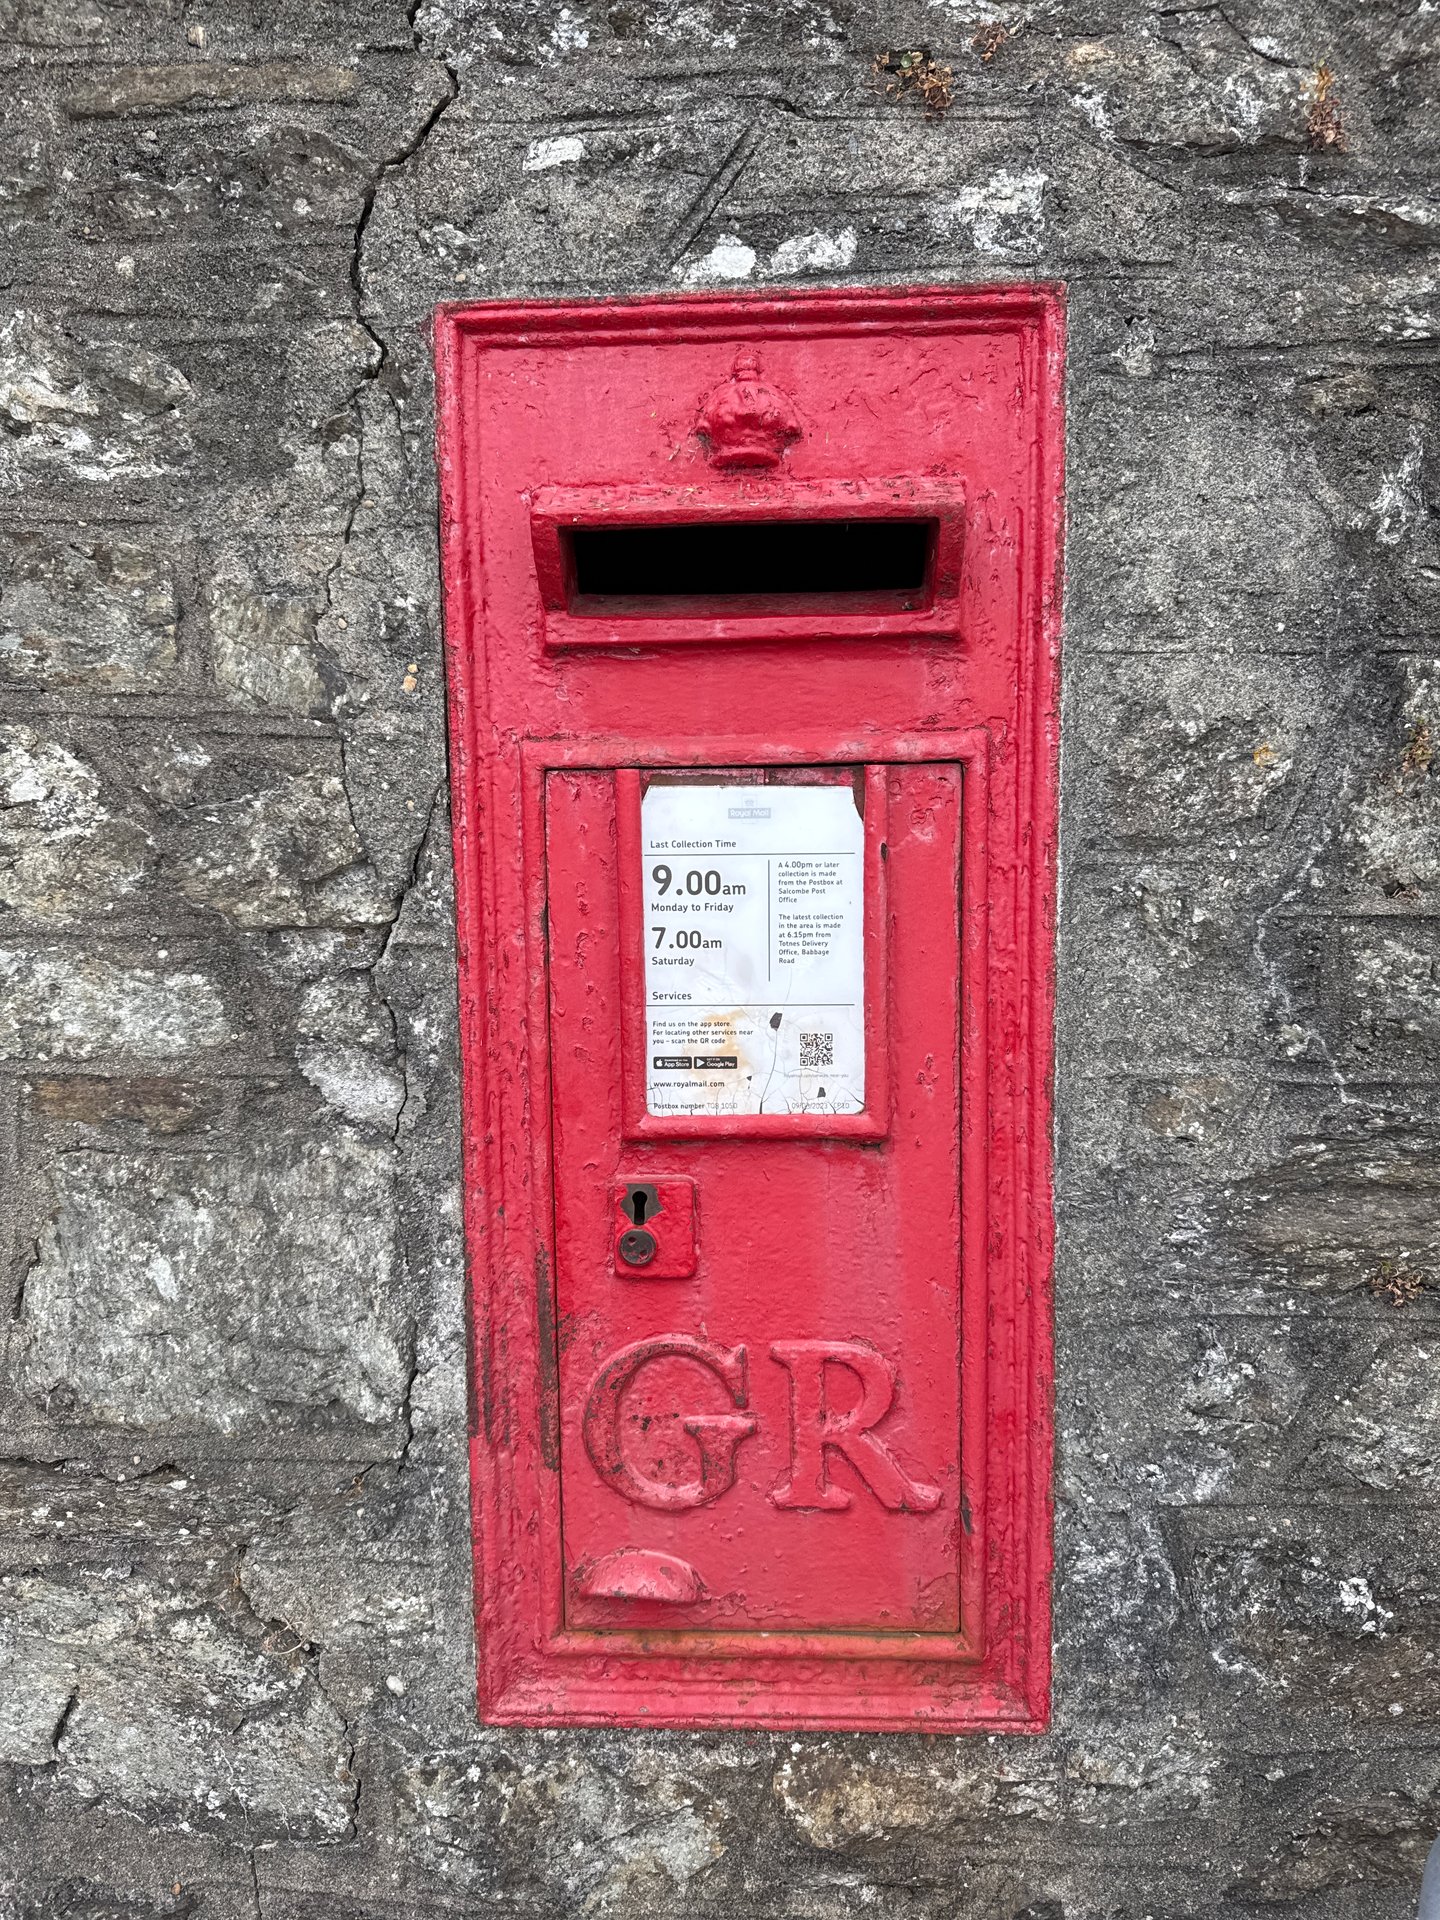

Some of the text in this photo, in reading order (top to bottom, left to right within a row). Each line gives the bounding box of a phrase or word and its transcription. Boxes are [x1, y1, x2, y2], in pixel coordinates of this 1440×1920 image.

[730, 809, 751, 817] Royal
[650, 840, 736, 848] Last Collection Time
[652, 865, 746, 896] 9.00am
[651, 903, 688, 913] Monday
[705, 903, 734, 913] Friday
[652, 927, 722, 949] 7.00am
[652, 956, 694, 967] Saturday
[653, 992, 692, 1000] Services
[653, 1081, 725, 1089] www.royalmail.com
